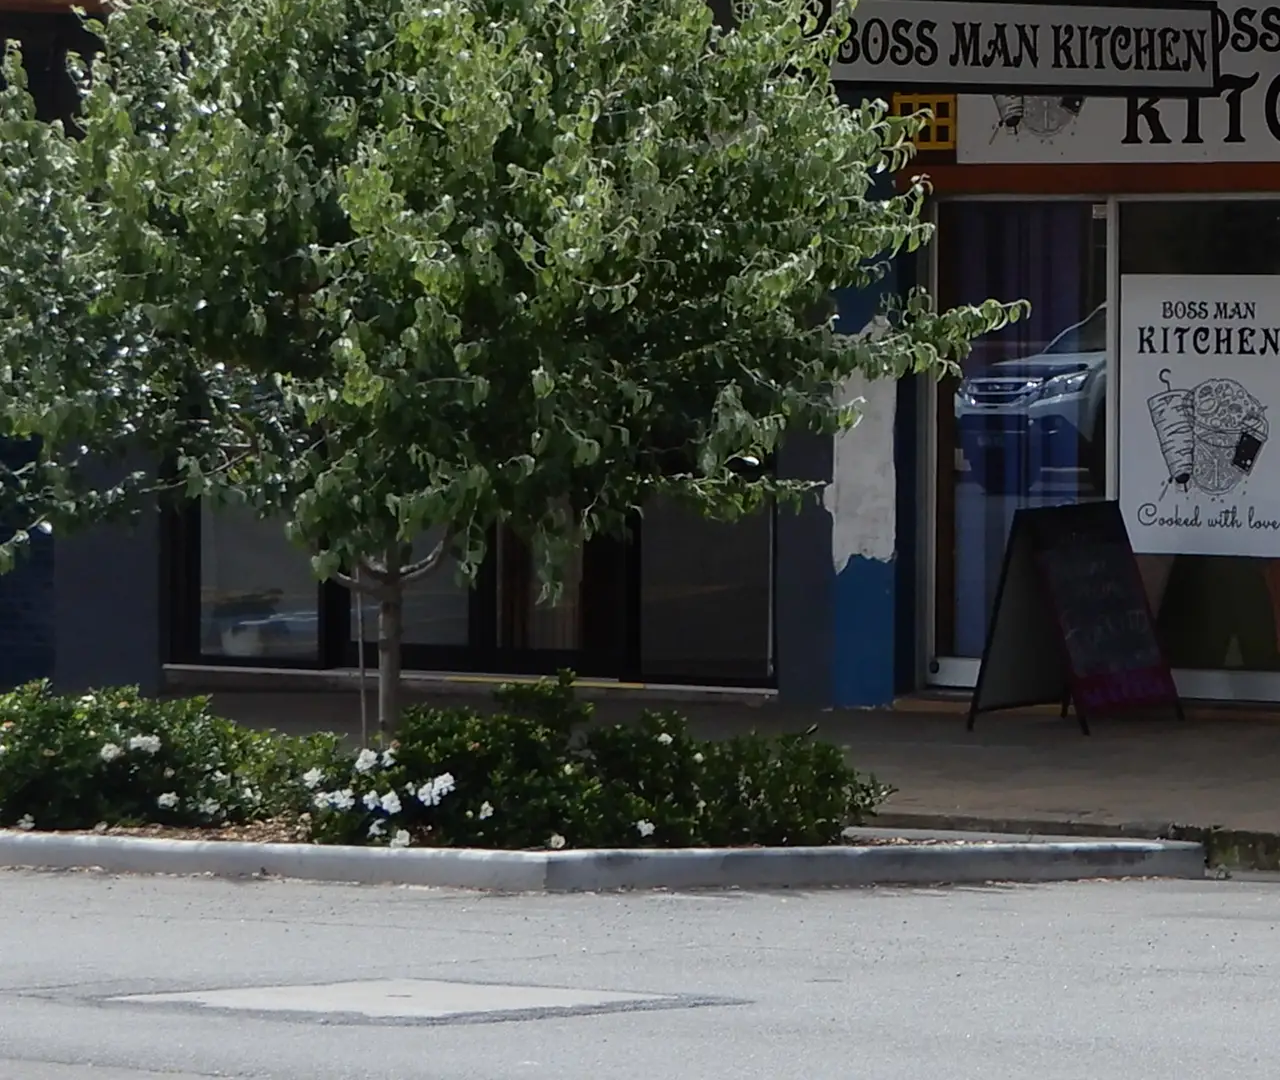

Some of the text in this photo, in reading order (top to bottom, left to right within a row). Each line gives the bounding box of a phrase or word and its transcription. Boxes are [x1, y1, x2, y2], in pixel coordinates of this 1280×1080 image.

[949, 21, 1040, 69] MAN
[1051, 24, 1208, 72] KITCHEN
[1161, 300, 1257, 321] BOSS MAN
[1137, 502, 1280, 531] Cooked with love
